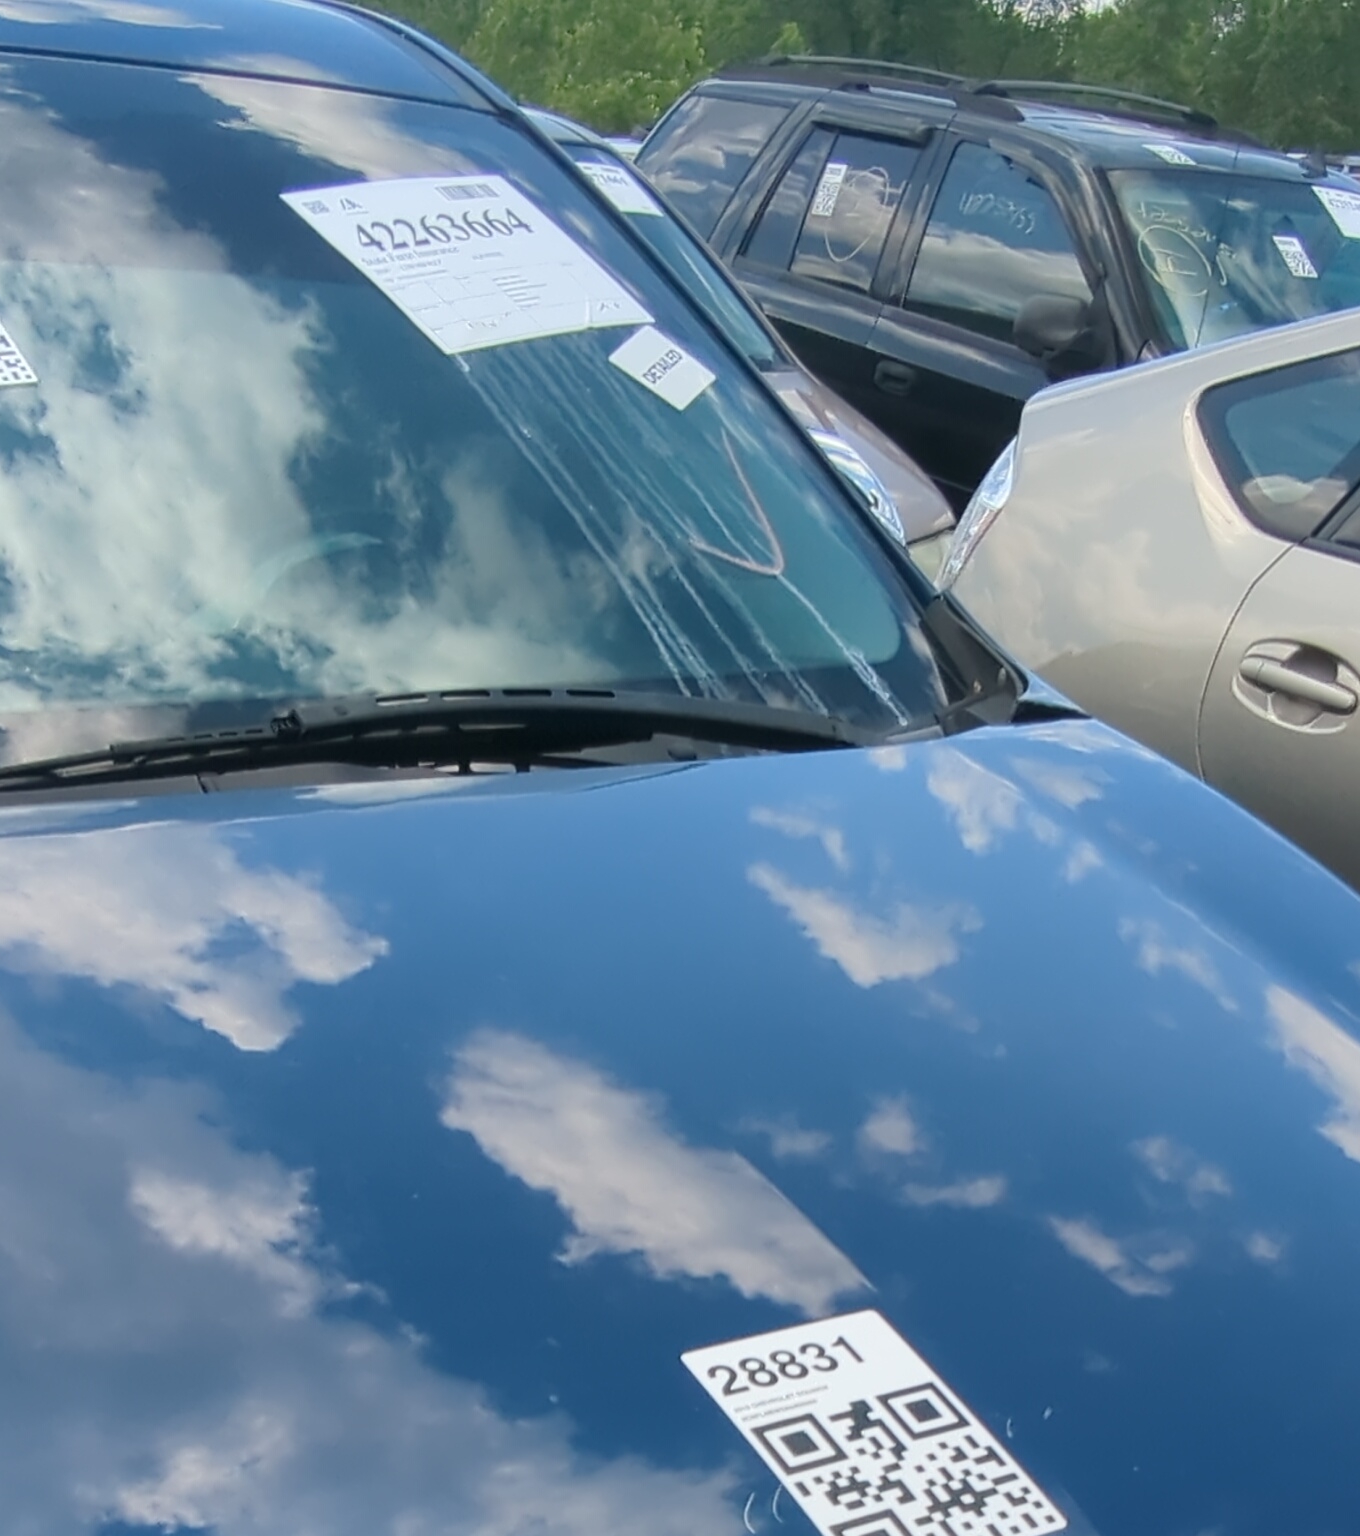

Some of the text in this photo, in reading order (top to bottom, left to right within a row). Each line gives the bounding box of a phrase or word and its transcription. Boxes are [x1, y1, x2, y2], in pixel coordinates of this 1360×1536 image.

[355, 207, 535, 252] 42263664
[641, 348, 683, 386] DETAILED
[706, 1335, 865, 1397] 28831
